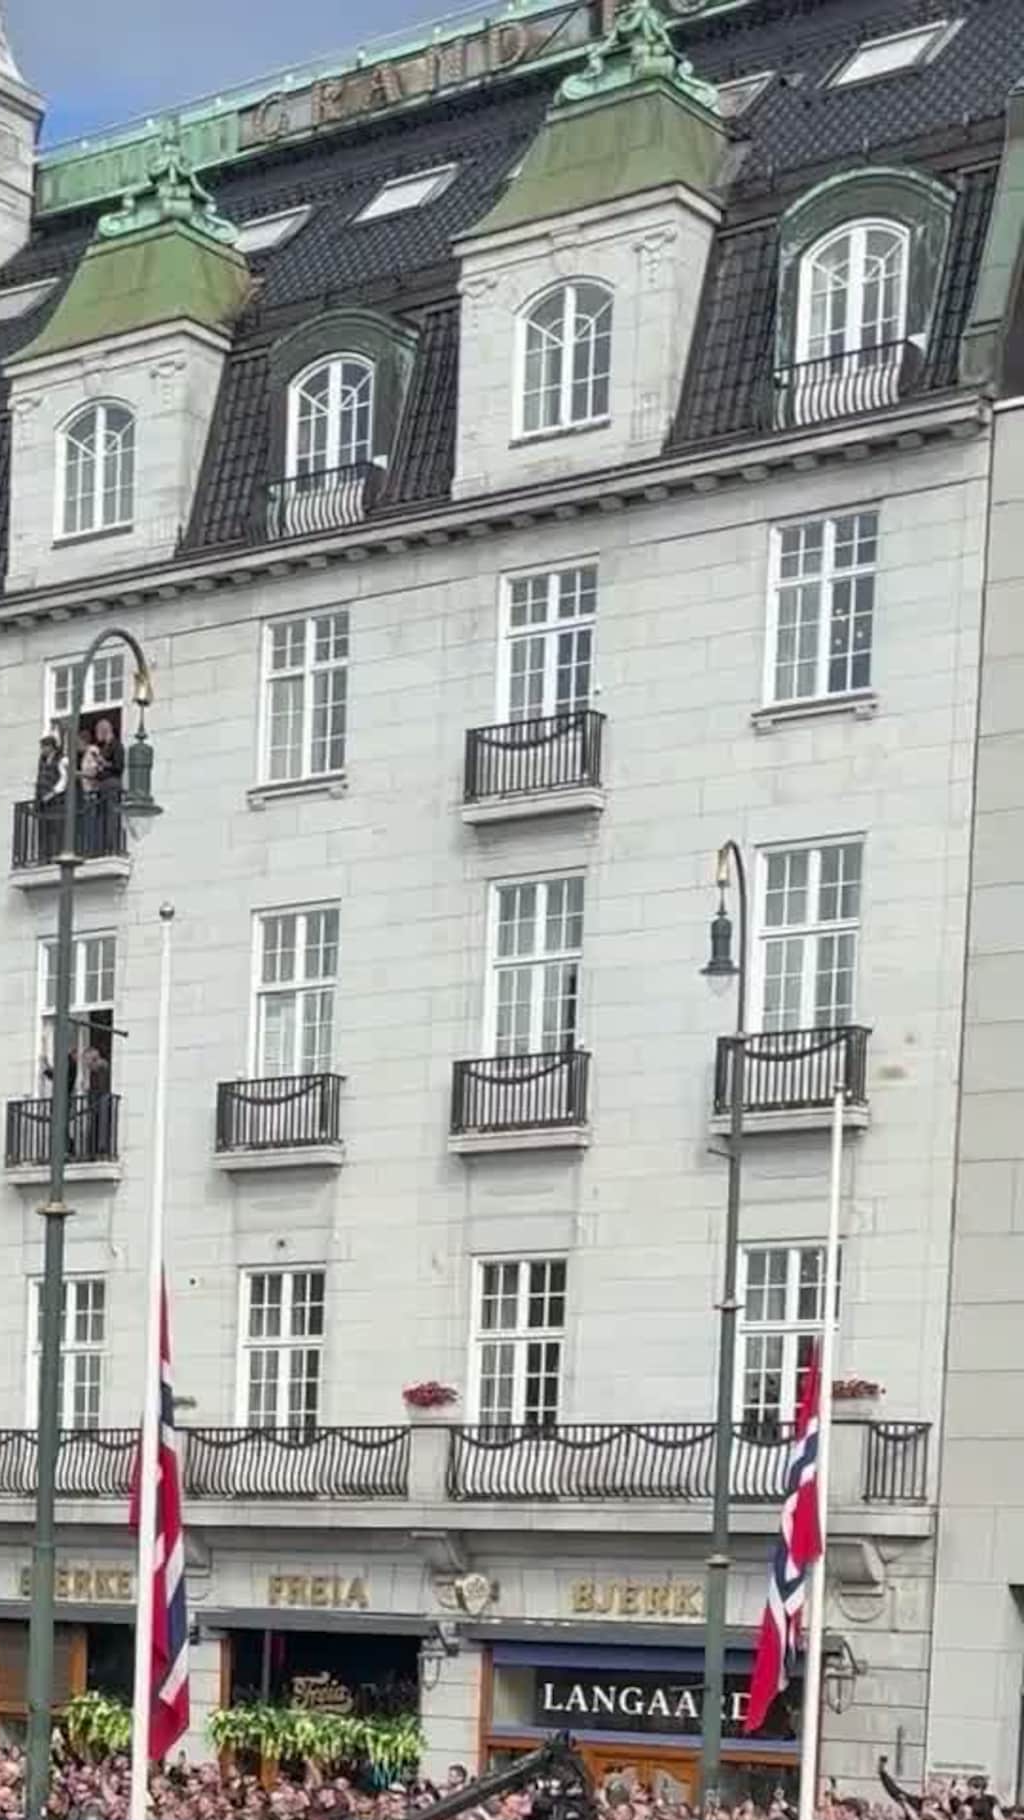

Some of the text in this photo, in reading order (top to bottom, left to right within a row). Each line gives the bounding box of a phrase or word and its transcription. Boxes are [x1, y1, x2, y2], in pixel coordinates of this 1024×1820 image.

[252, 22, 527, 138] GRAND
[19, 1567, 134, 1600] BERKE
[267, 1574, 370, 1609] FREIA
[570, 1578, 705, 1618] BJERK
[542, 1682, 752, 1721] LANGAAD
